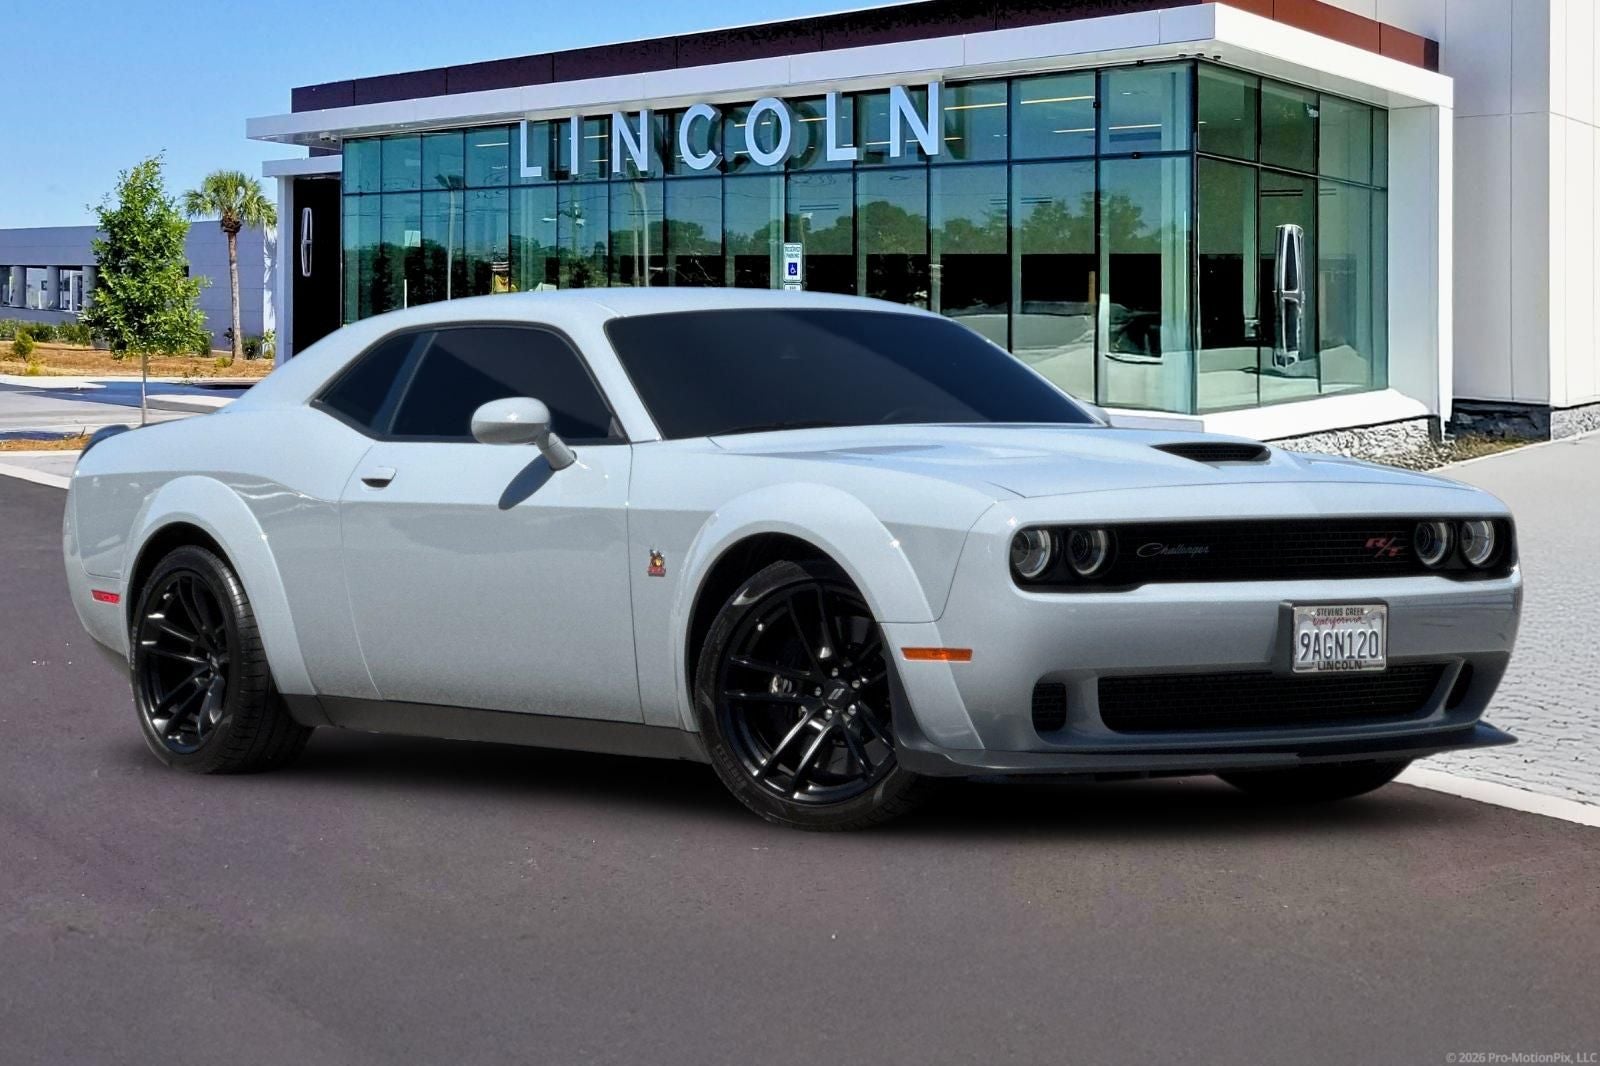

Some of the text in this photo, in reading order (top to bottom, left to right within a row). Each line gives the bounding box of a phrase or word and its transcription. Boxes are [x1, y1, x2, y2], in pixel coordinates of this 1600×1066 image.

[519, 81, 941, 178] LINCOLN
[1136, 542, 1210, 558] Challenger
[1364, 536, 1404, 558] R/T
[1316, 607, 1365, 617] STEVENS CREEK
[1312, 617, 1364, 630] California
[1300, 630, 1379, 661] 9AGN120
[1317, 660, 1362, 671] LINCOLN
